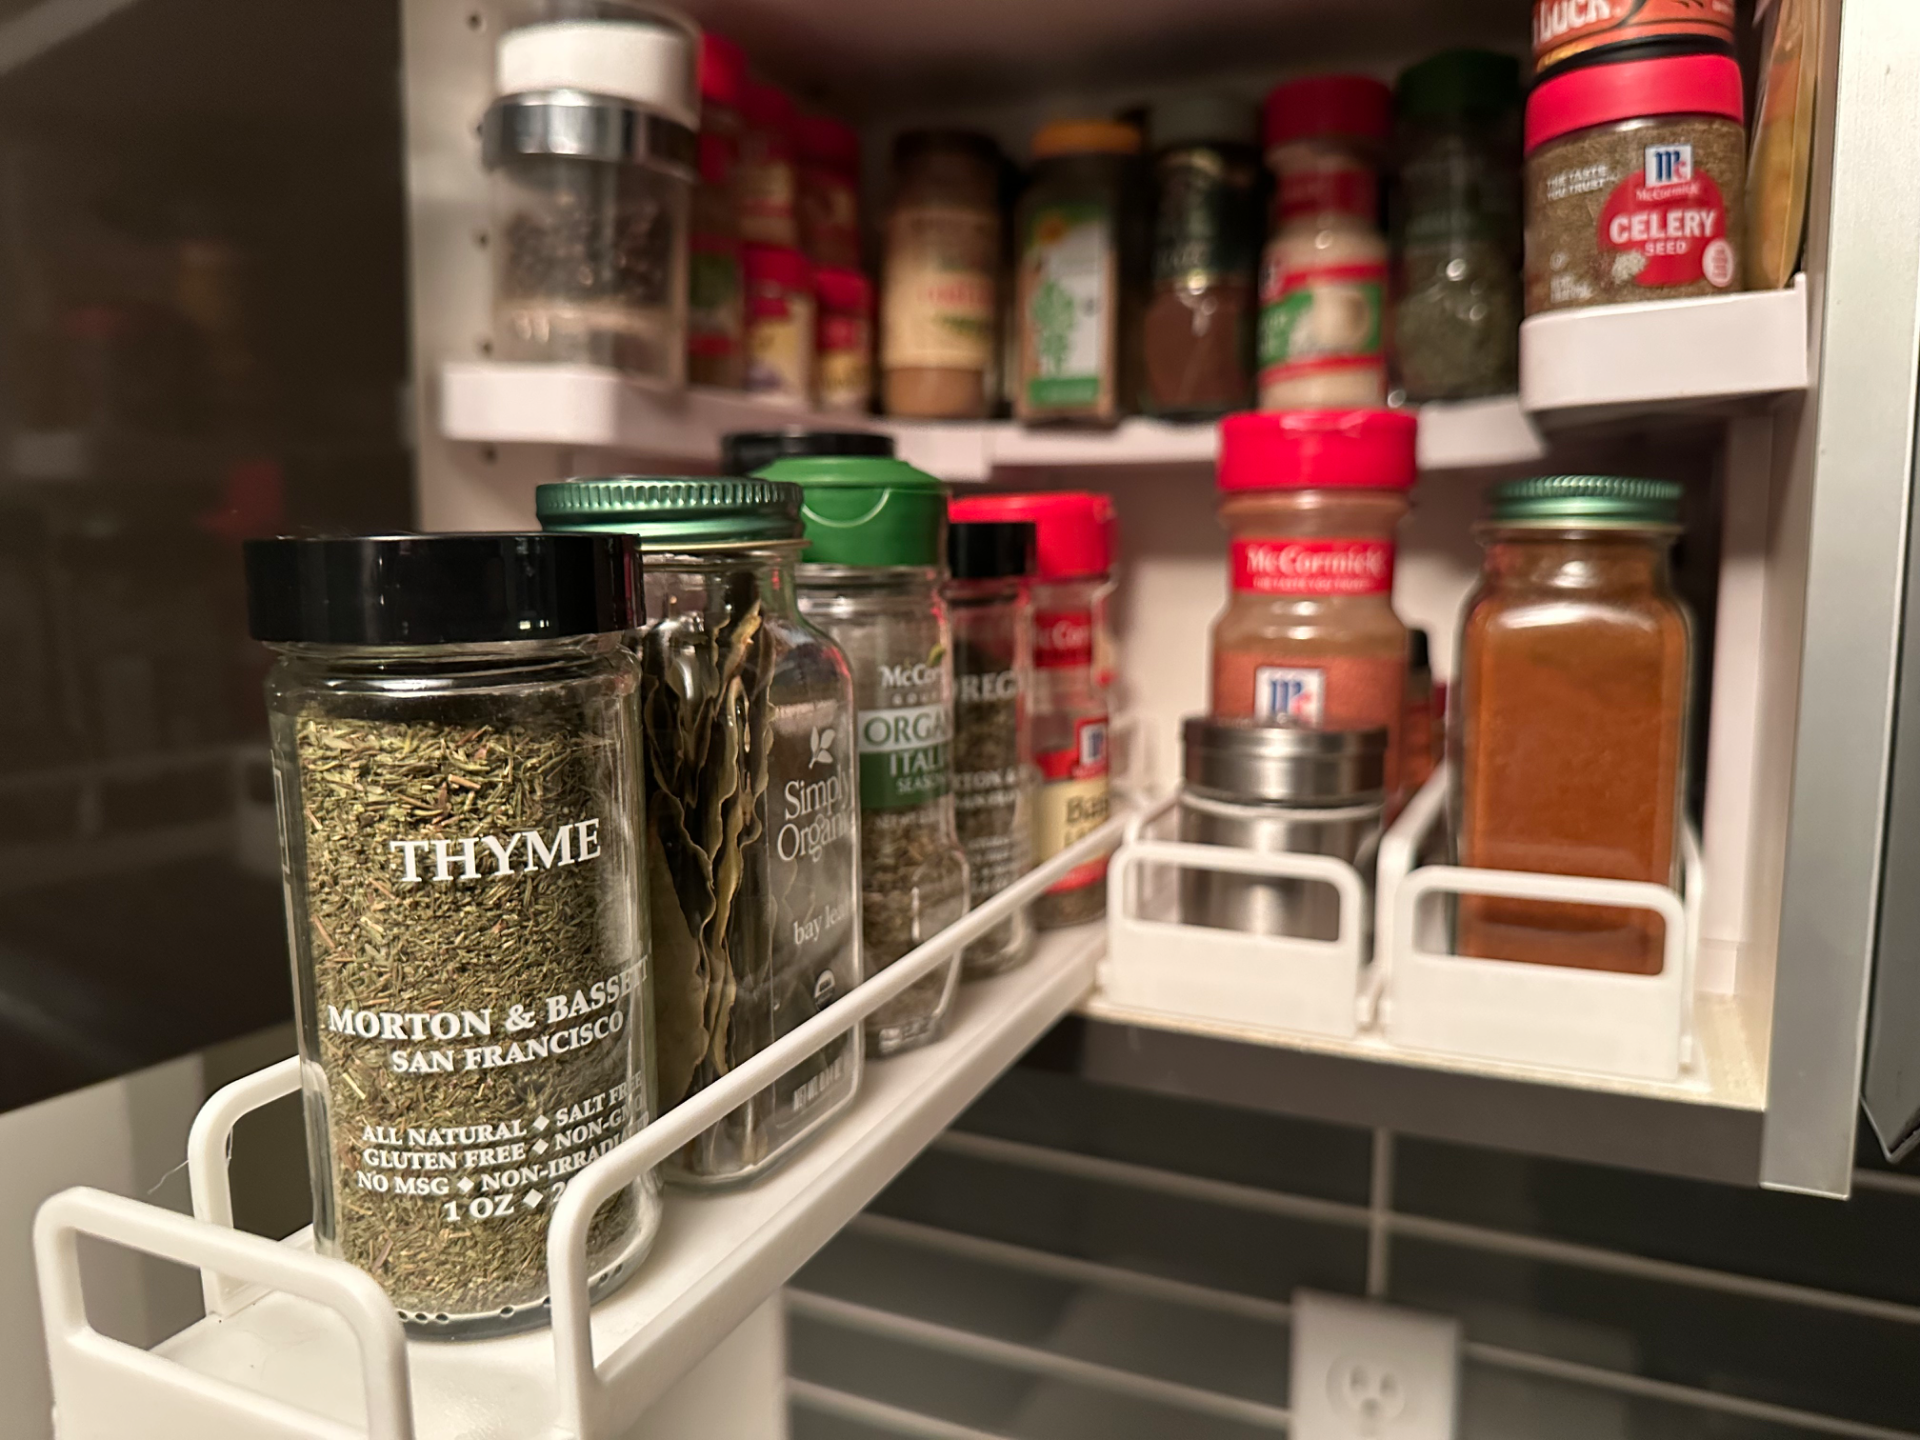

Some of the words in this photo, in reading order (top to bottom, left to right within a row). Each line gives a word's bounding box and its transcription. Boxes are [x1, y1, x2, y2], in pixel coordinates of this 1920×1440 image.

[1636, 182, 1701, 200] McCormick
[1608, 209, 1717, 245] CELERY
[1644, 241, 1688, 256] SEED
[1246, 545, 1388, 576] McCormick
[777, 801, 855, 864] Organi
[390, 818, 601, 883] THYME
[793, 914, 823, 946] bay
[327, 1005, 493, 1041] MORTON
[505, 1003, 537, 1033] &
[546, 955, 648, 1024] BASSETT
[392, 1049, 454, 1074] SAN
[464, 1010, 624, 1071] FRANCISCO
[362, 1124, 403, 1146] ALL
[408, 1119, 527, 1146] NATURAL
[555, 1093, 606, 1127] SALT
[362, 1148, 457, 1171] GLUTEN
[465, 1142, 527, 1170] FREE
[357, 1170, 389, 1192] NO
[394, 1177, 450, 1197] MSG
[444, 1201, 461, 1223] 1
[469, 1193, 515, 1220] OZ
